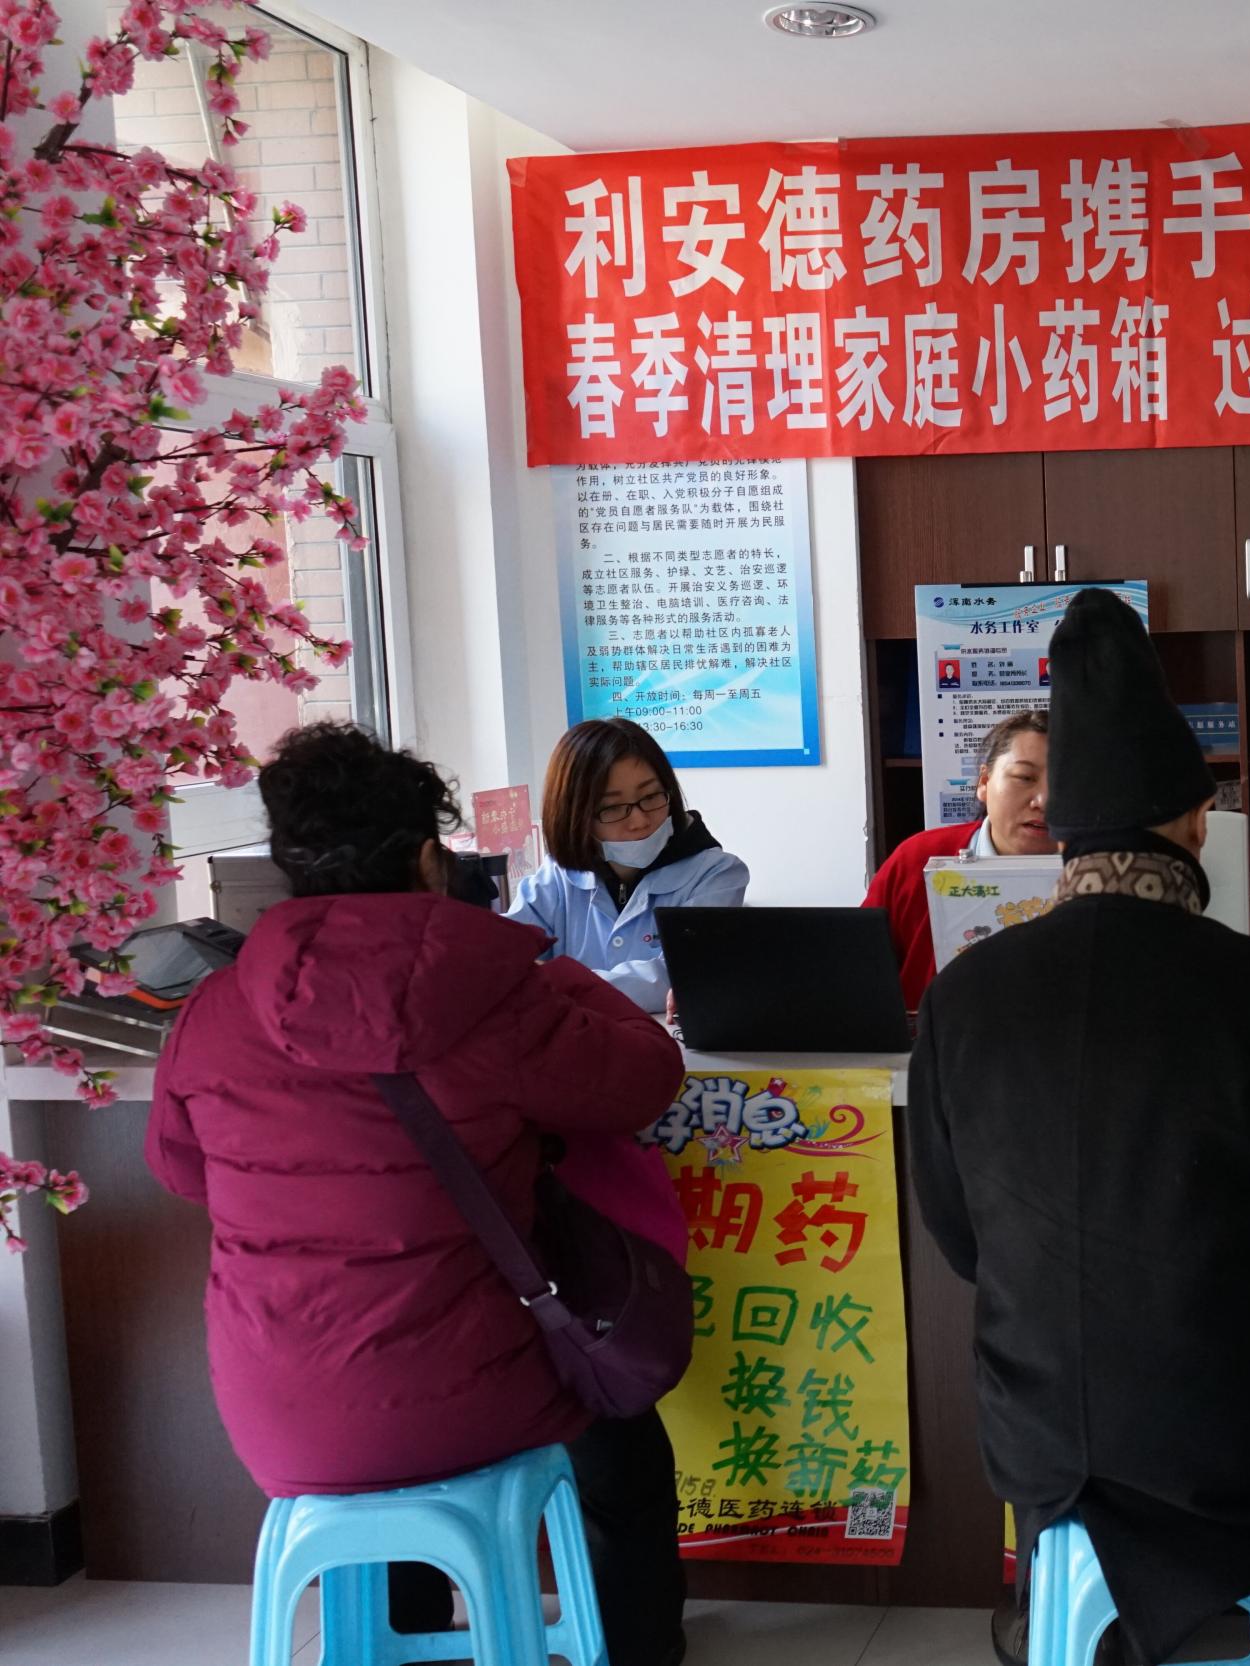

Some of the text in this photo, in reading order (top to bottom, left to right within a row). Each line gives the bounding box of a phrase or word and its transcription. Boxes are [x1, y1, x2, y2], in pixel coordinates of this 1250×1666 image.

[566, 296, 1169, 438] 春季清理家庭小药箱
[576, 468, 777, 487] 作用，树立社区共产党员的良好形象。
[577, 484, 784, 502] 以在册、在职、入党积极分子自愿组成
[579, 515, 785, 534] 区存在问题与居民需要随时开展为民服
[603, 548, 781, 564] 二、根据不同类型志愿者的特长，
[582, 563, 787, 580] 成立社区服务、护绿、文艺、治安巡逻
[584, 595, 789, 611] 境卫生整治、电脑培训、医疗咨询、法
[585, 611, 743, 626] 律服务等各种形式的服务活动。
[608, 625, 791, 641] 三、志愿者以帮助社区内孤寡老人
[970, 620, 1040, 634] 水务工作室
[587, 641, 791, 657] 及弱势群体解决日常生活遇到的困难为
[588, 657, 792, 673] 主，帮助辖区居民排忧解难，解决社区
[589, 675, 640, 688] 实际问题。
[720, 1350, 860, 1441] 换钱
[711, 1420, 908, 1510] 换新药
